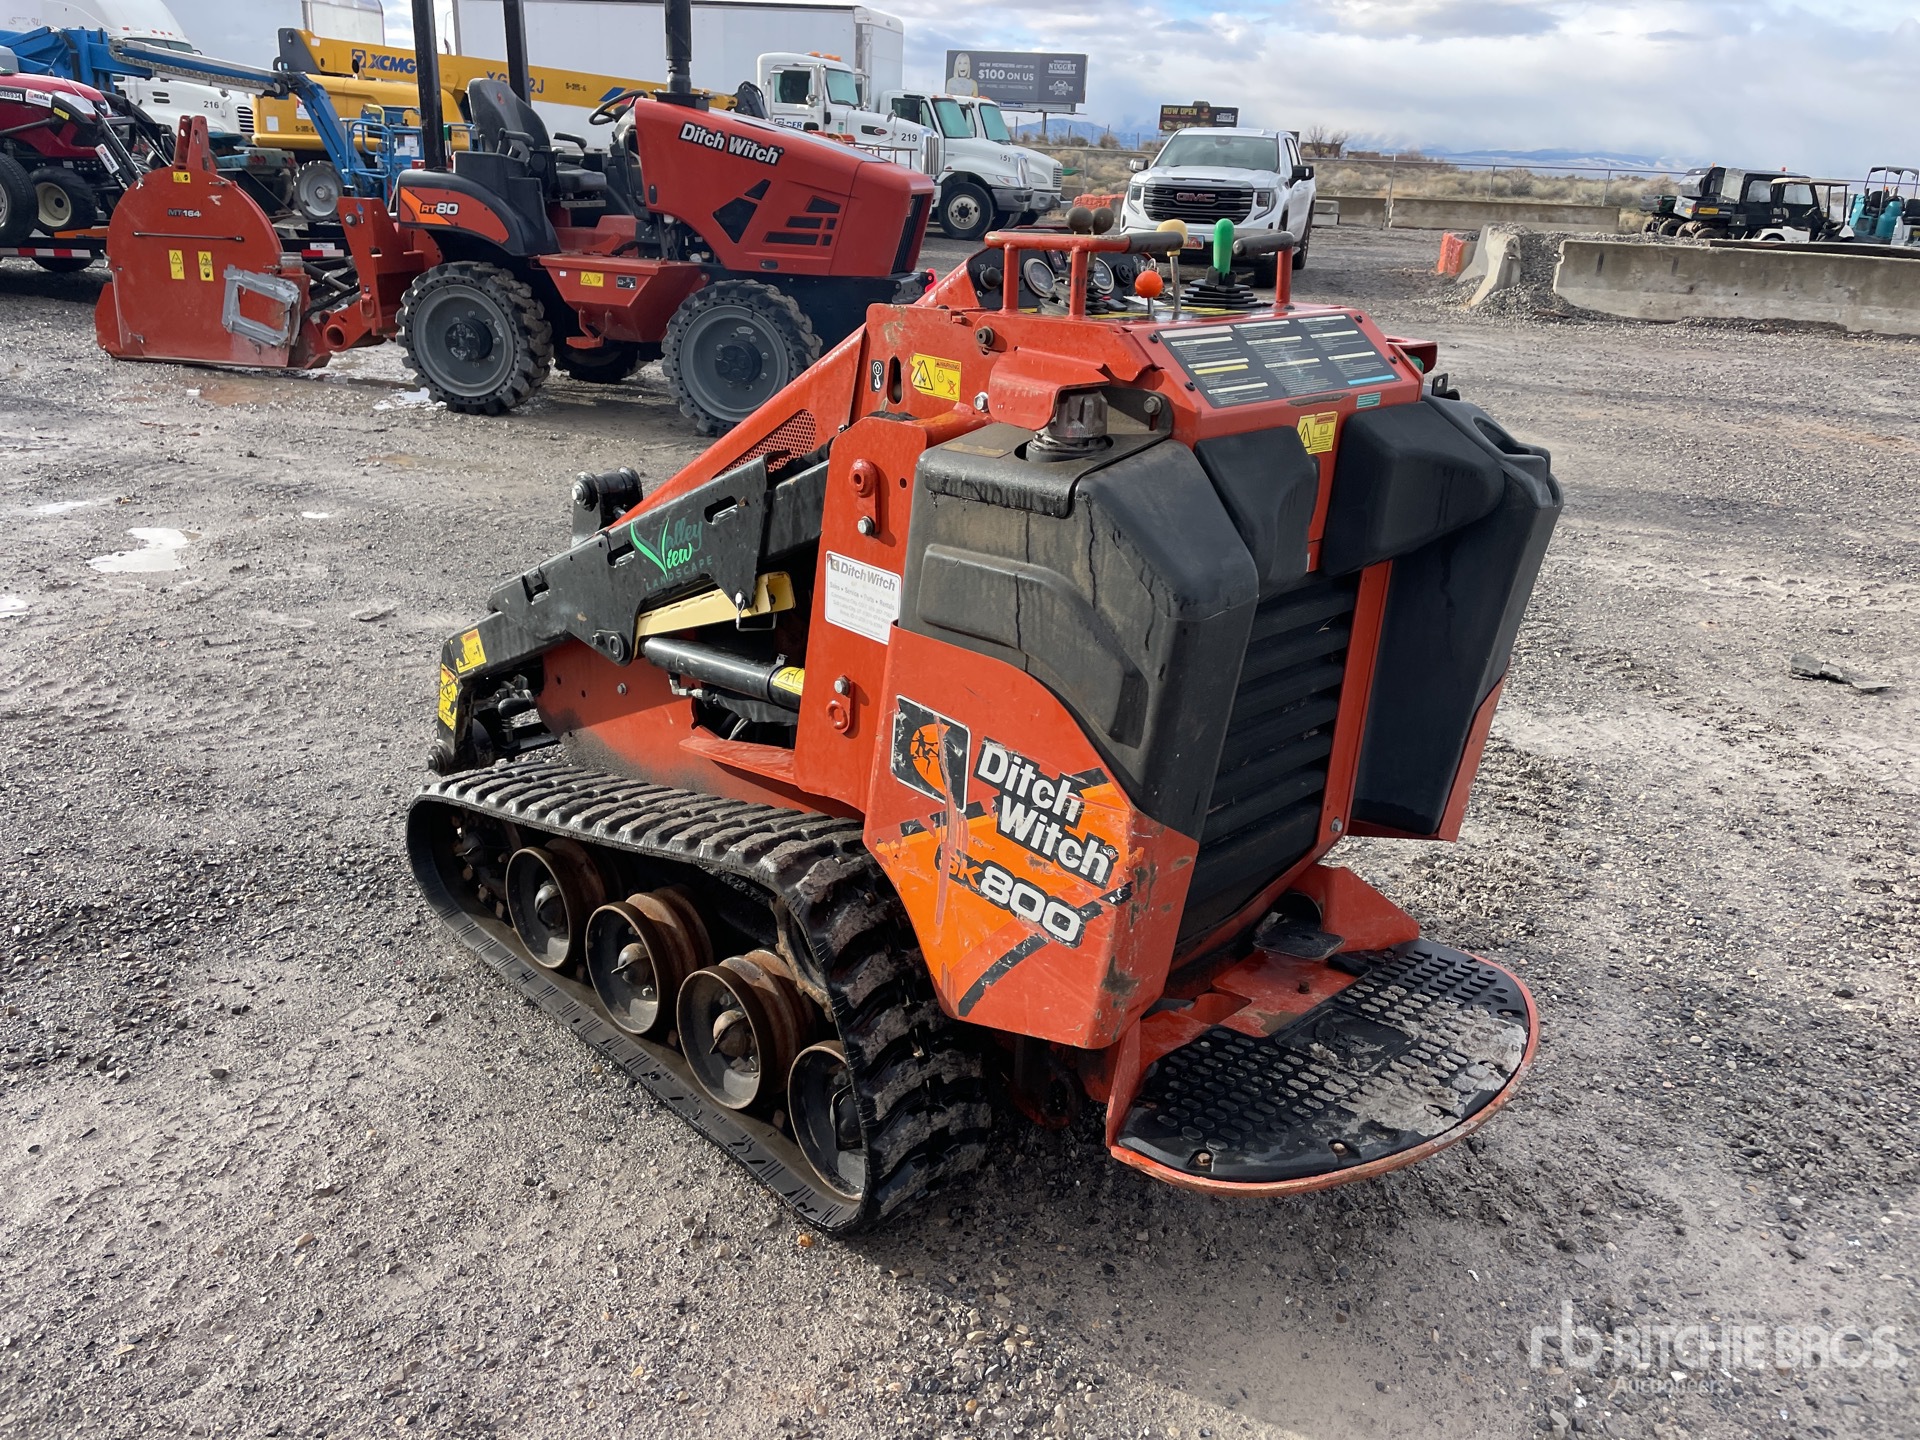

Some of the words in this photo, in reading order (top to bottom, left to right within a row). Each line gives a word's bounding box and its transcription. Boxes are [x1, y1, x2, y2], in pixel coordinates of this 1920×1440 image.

[369, 54, 417, 74] XCMG
[978, 69, 1006, 80] $100
[1007, 72, 1021, 80] ON
[1022, 73, 1034, 81] US
[203, 100, 220, 109] 216
[1163, 107, 1179, 115] NOW
[1180, 108, 1198, 116] OPEN
[680, 122, 726, 150] Ditch
[728, 136, 779, 164] Witch
[901, 132, 918, 143] 219
[1176, 192, 1216, 203] GMC
[168, 208, 201, 218] MT164
[421, 202, 459, 215] RT80
[645, 555, 713, 592] LANDSCAPE
[840, 561, 867, 582] Ditch
[976, 744, 1081, 823] Ditch
[1000, 794, 1110, 883] Witch
